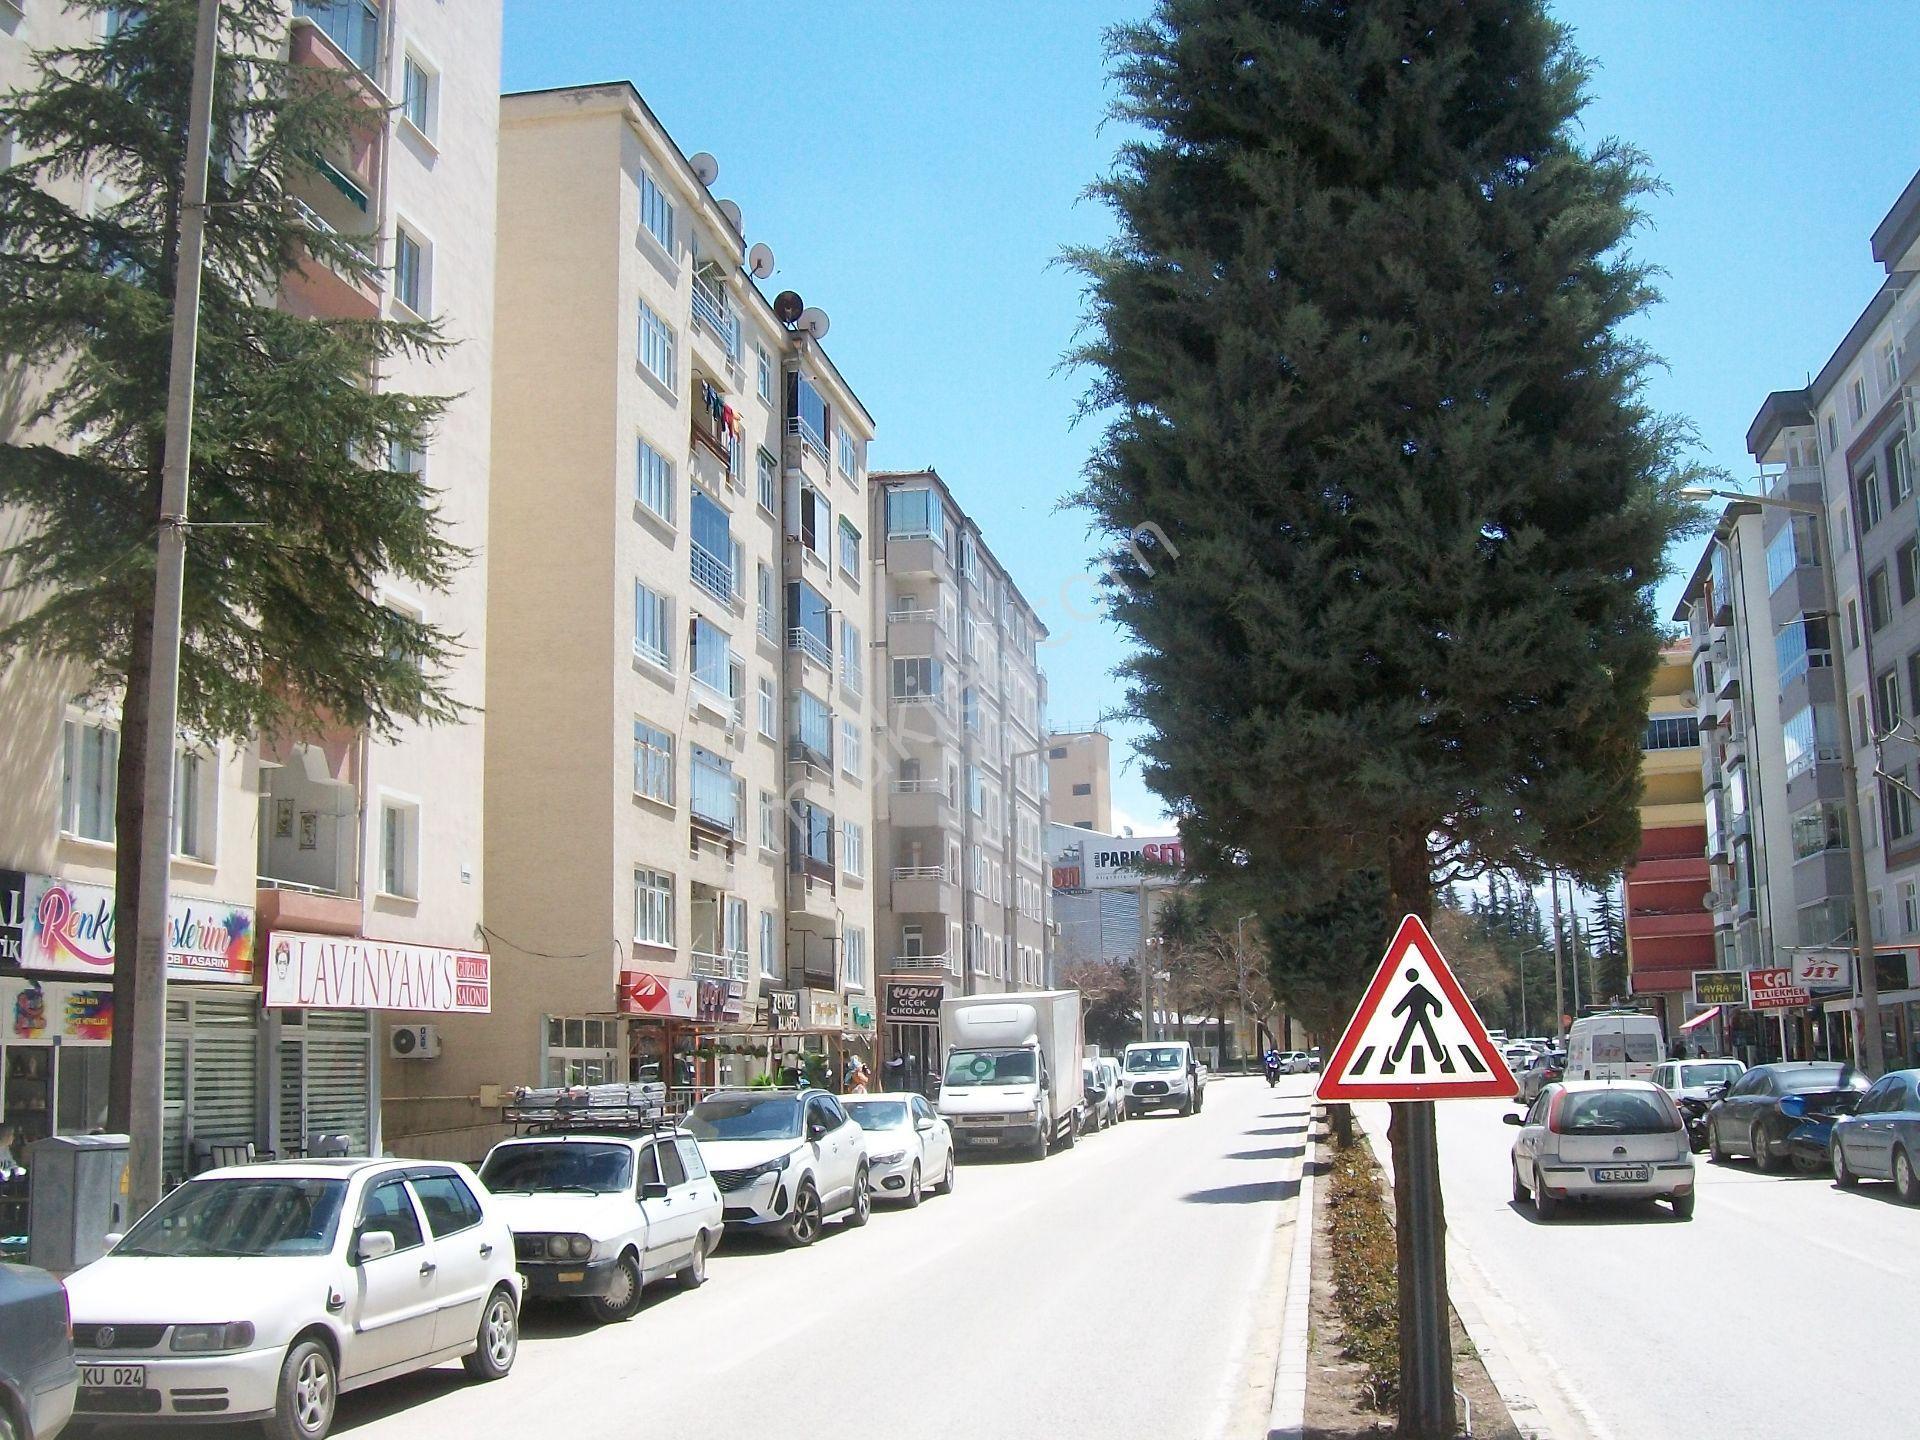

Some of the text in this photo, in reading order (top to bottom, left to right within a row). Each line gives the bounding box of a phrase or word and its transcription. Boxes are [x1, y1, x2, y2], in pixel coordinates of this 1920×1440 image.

[1801, 966, 1840, 978] JET
[457, 986, 487, 1006] SALONU
[1601, 1171, 1611, 1180] 42
[82, 1368, 142, 1385] KU 024
